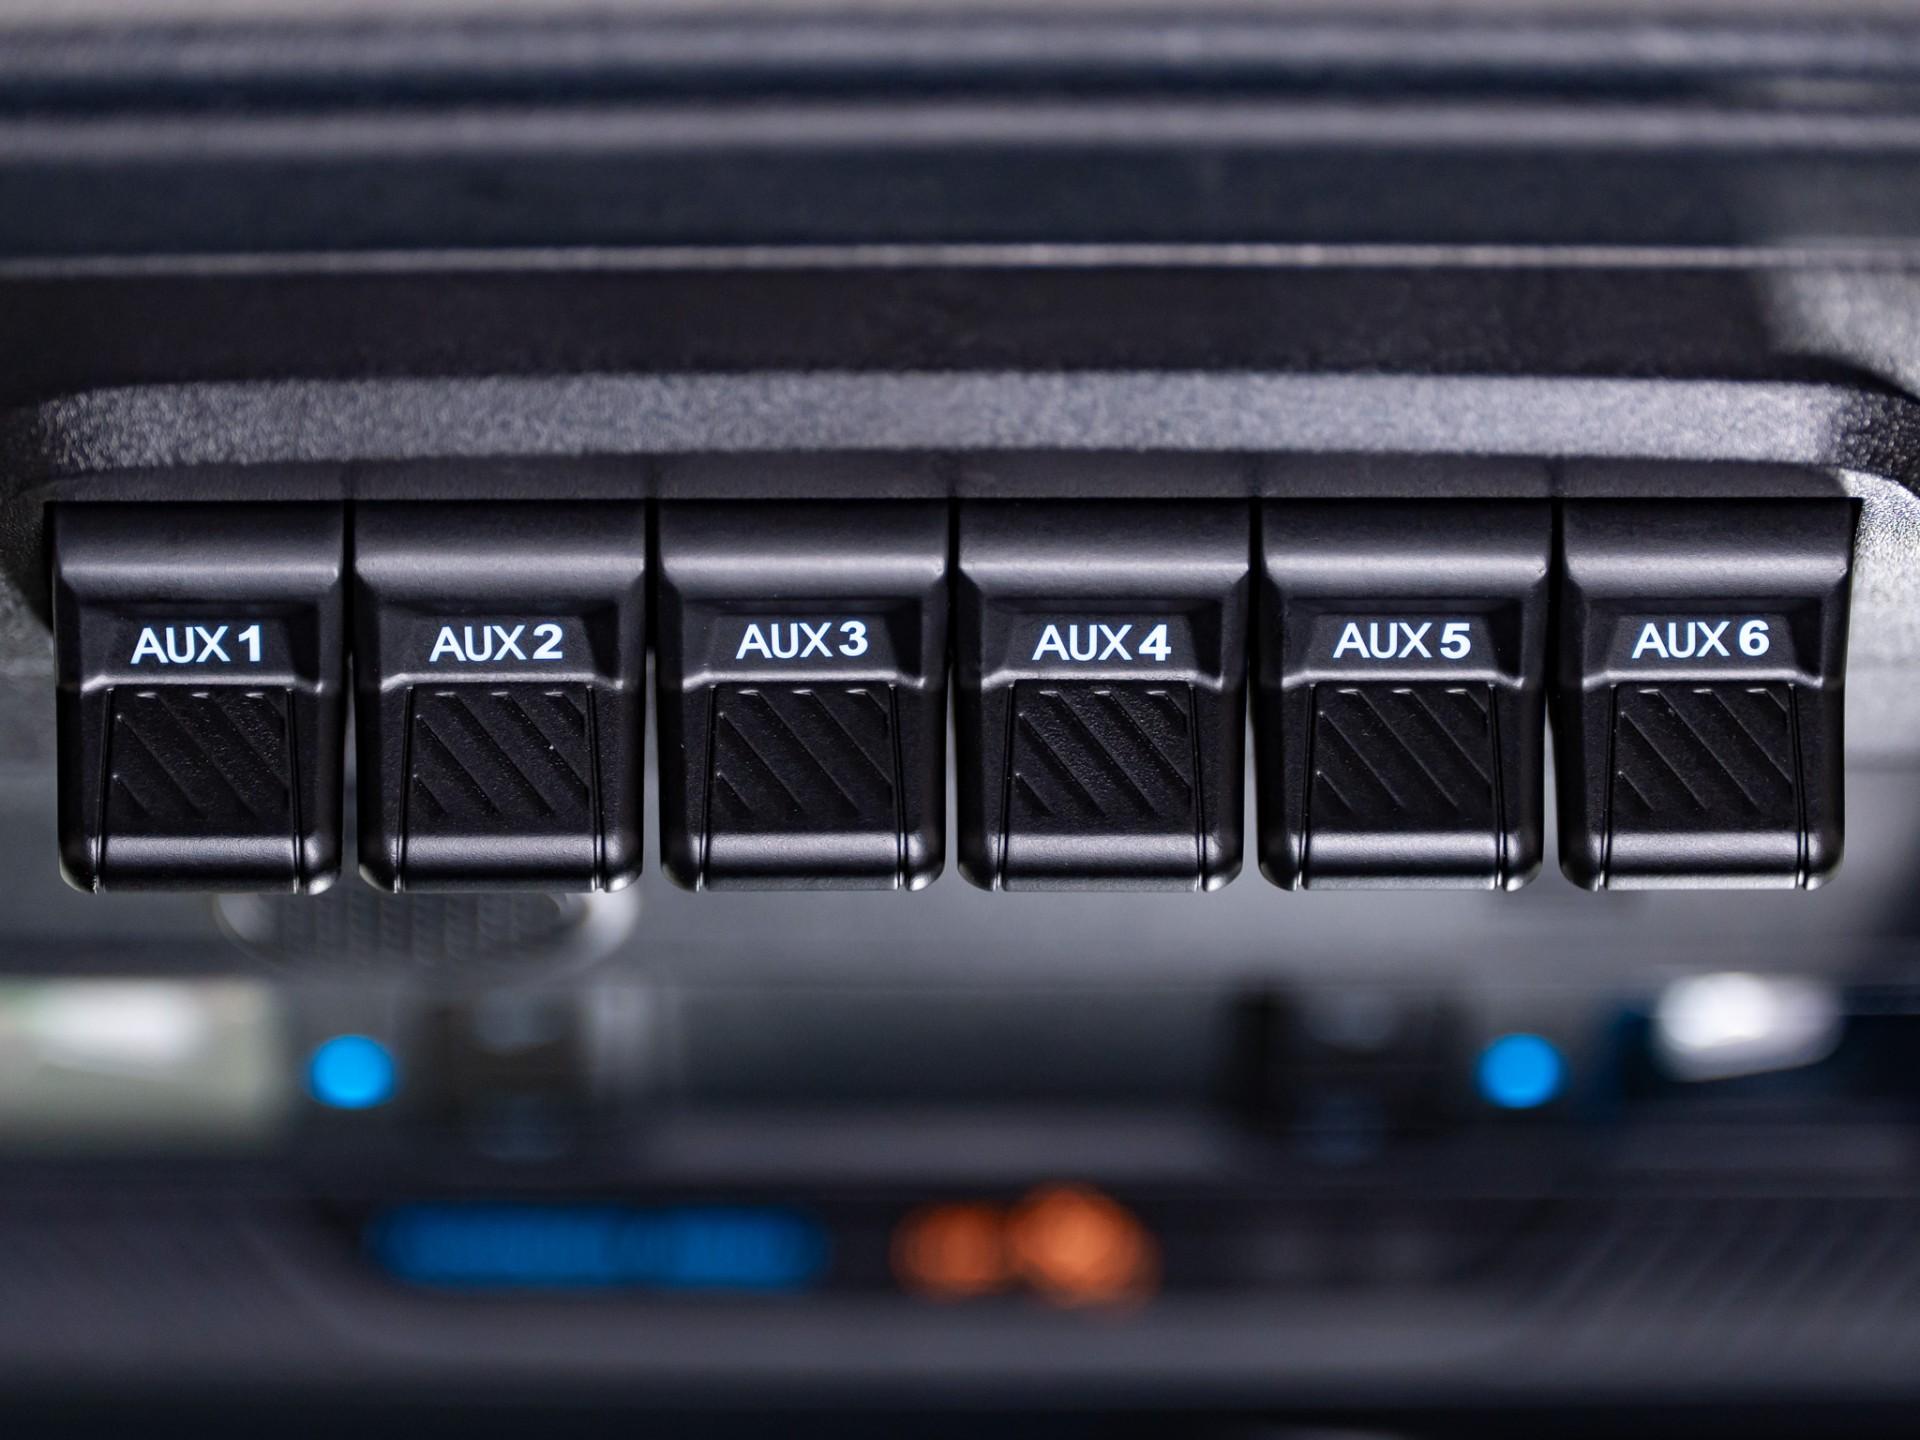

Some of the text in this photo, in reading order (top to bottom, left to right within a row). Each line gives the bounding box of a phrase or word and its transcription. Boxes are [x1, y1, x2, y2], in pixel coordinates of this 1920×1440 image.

[131, 625, 262, 663] AUX 1
[429, 624, 563, 662] AUX 2
[736, 621, 869, 659] AUX 3
[1032, 624, 1172, 661] AUX 4
[1333, 622, 1471, 660] AUX 5
[1632, 620, 1770, 659] AUX 6
